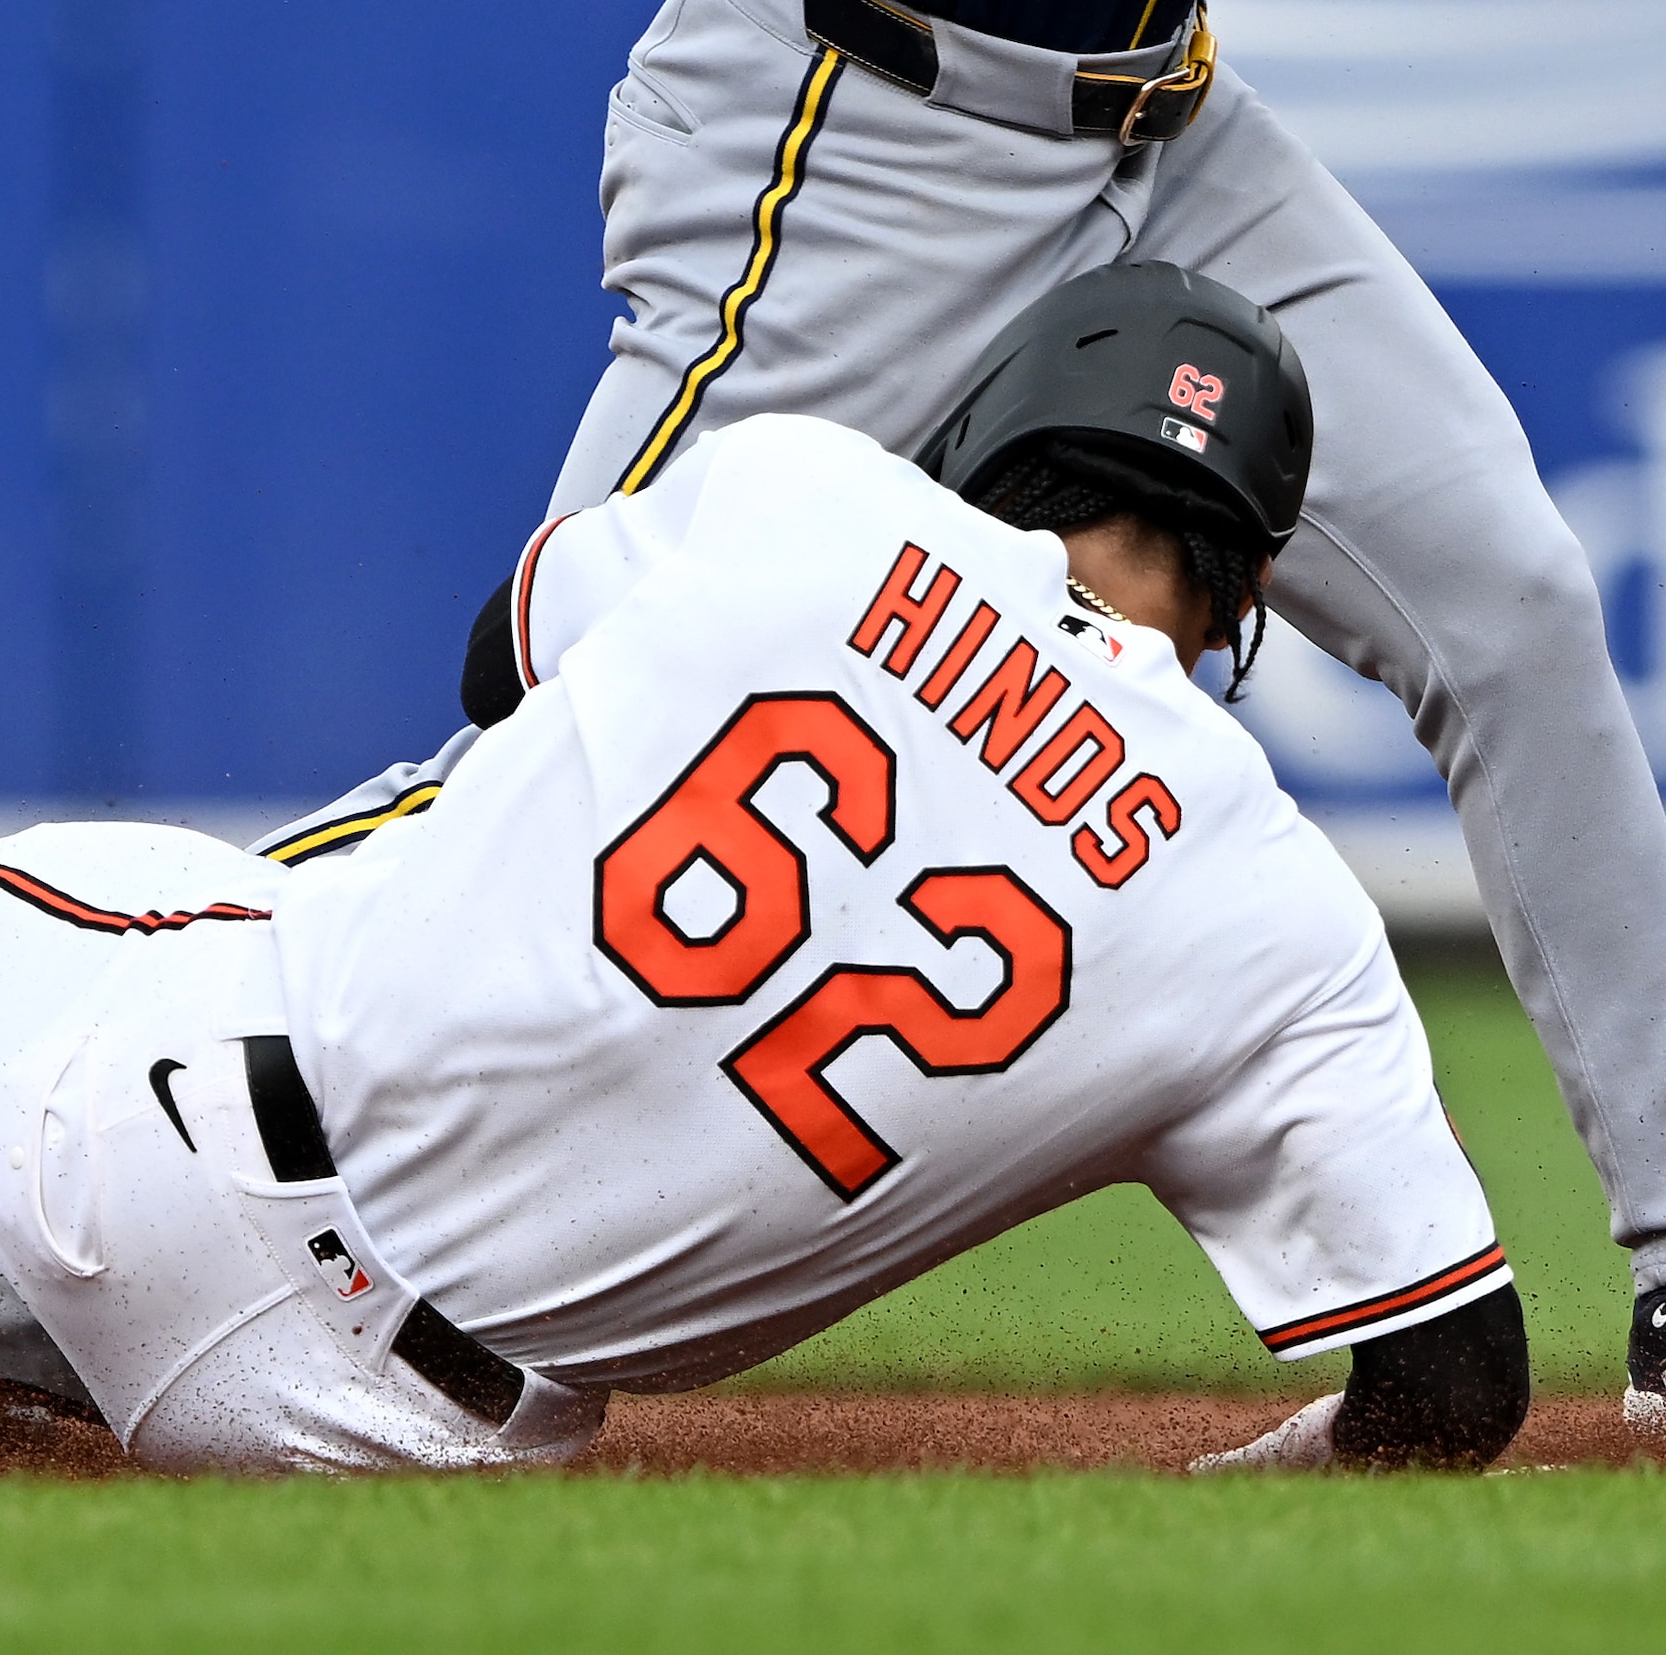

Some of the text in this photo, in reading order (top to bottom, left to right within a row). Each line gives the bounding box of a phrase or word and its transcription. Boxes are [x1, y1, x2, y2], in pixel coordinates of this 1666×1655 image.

[1168, 363, 1225, 422] 62
[845, 539, 1182, 890] HINDS
[593, 689, 1073, 1203] 62
